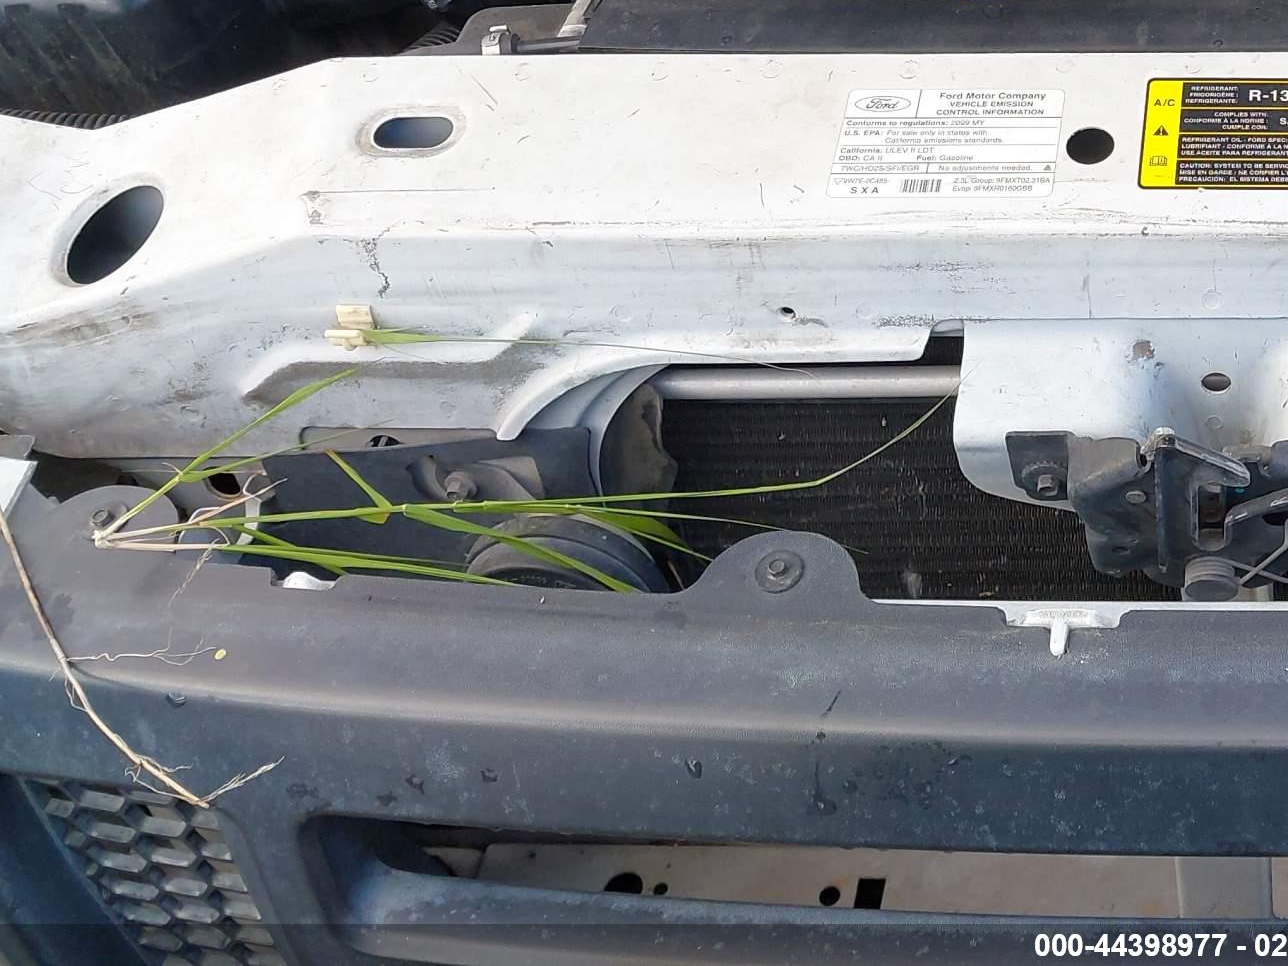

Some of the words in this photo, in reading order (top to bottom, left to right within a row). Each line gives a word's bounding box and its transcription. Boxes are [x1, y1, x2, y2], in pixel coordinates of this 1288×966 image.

[940, 92, 963, 100] Ford
[966, 92, 996, 100] Motor
[998, 92, 1047, 101] Company
[1154, 98, 1176, 107] A/C
